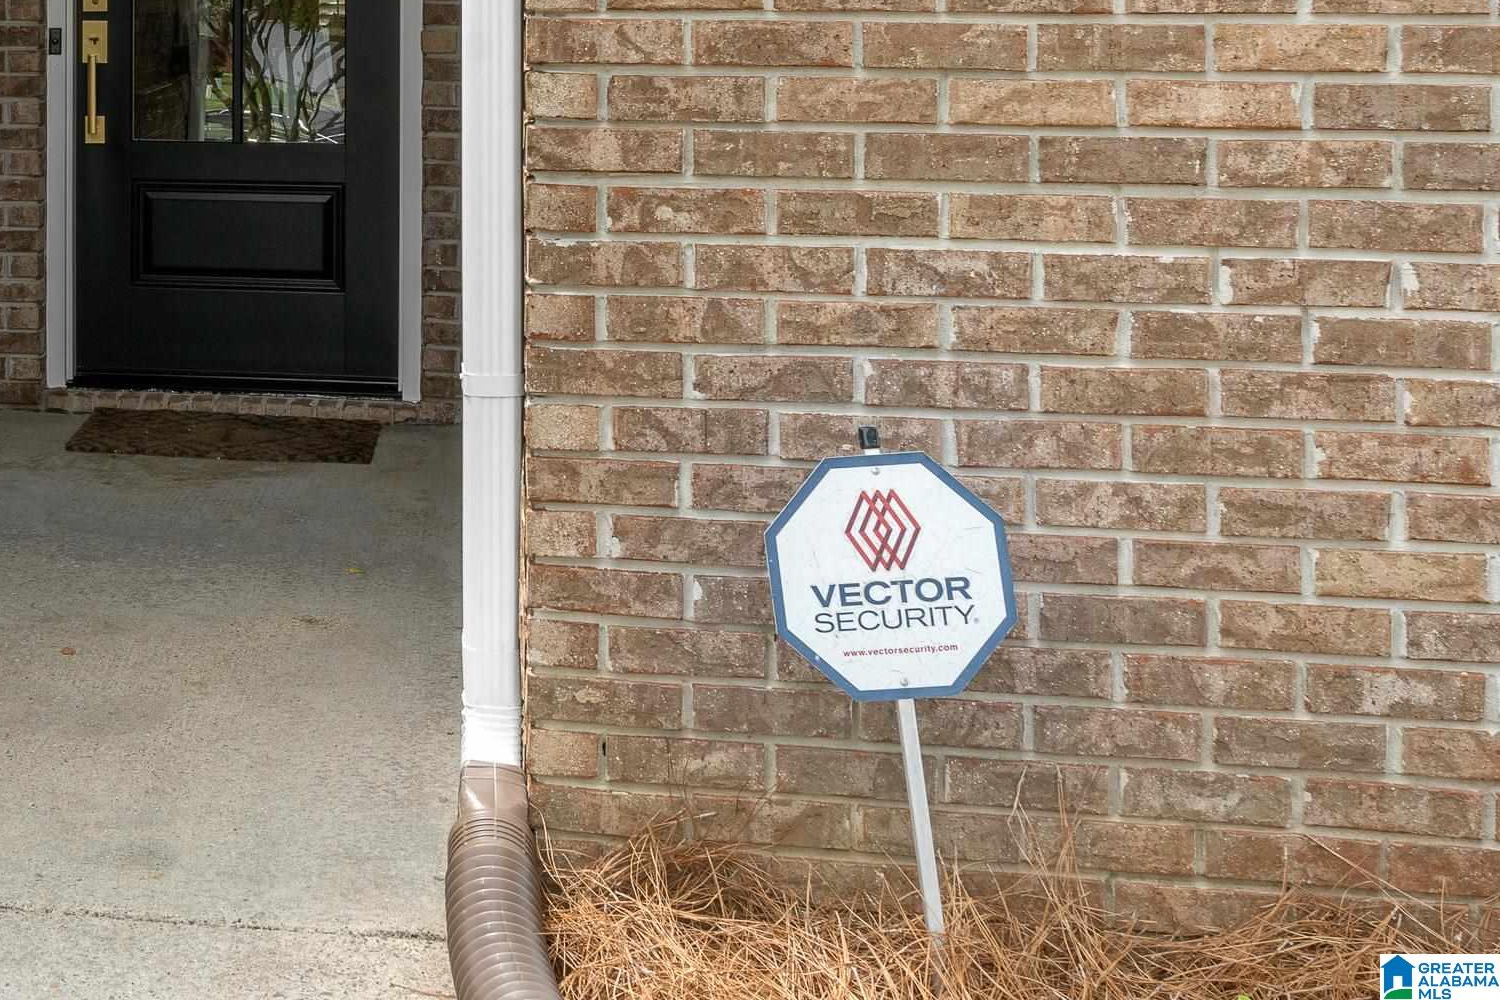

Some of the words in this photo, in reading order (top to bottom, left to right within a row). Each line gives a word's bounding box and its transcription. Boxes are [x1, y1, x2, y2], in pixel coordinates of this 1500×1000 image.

[811, 576, 973, 608] VECTOR
[814, 604, 975, 634] SECURITY
[843, 643, 959, 657] www.vectorsecurity.com
